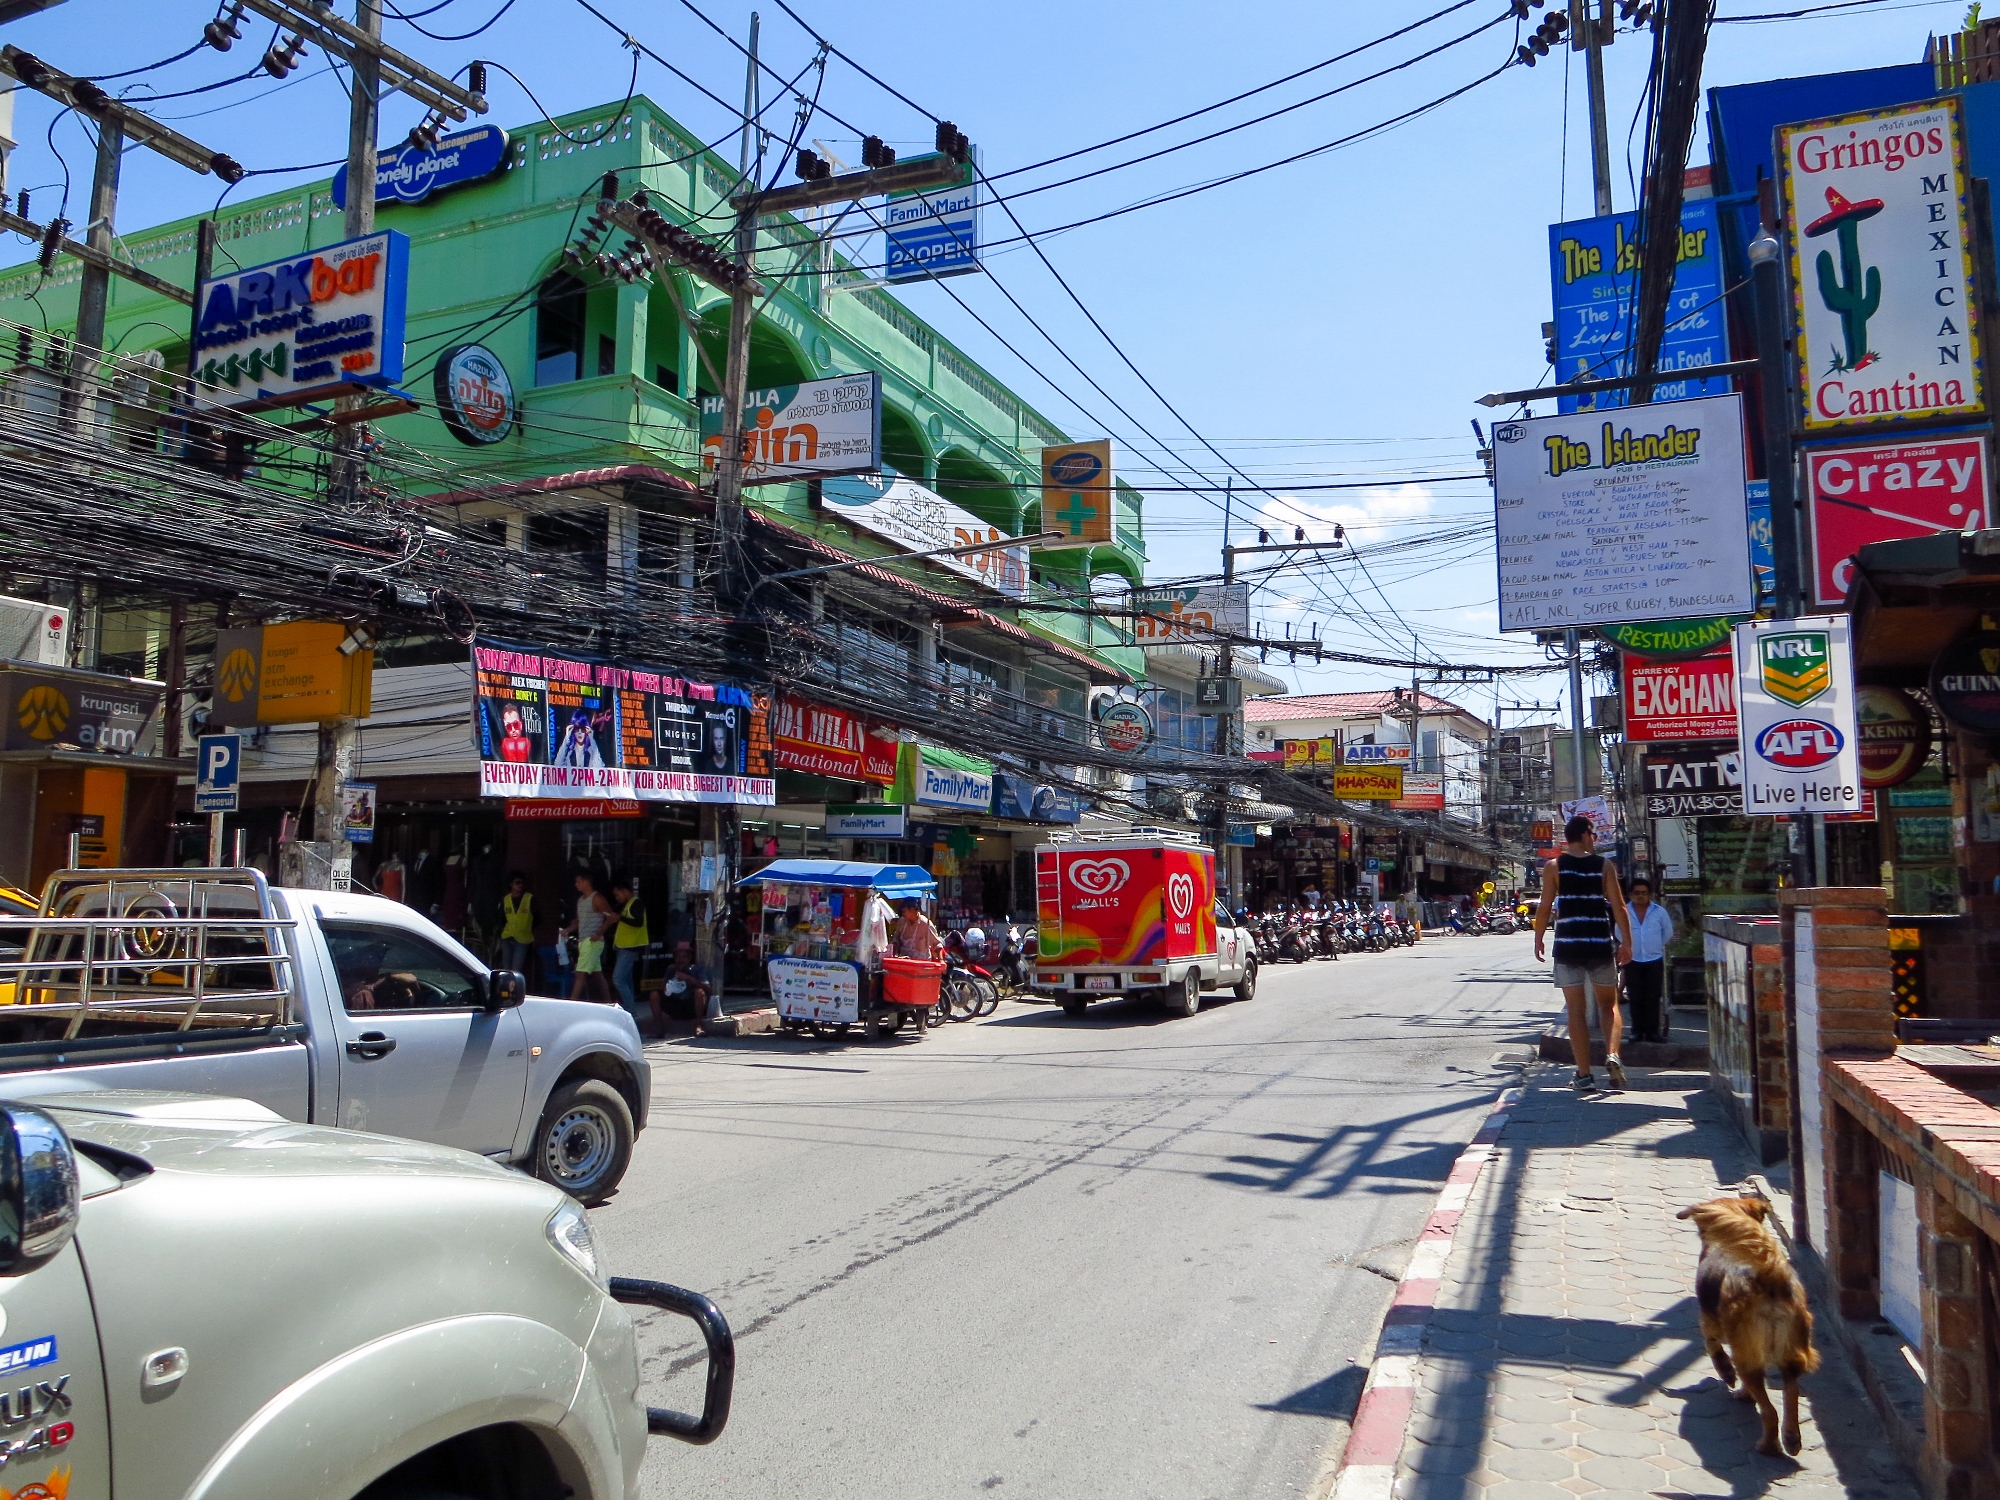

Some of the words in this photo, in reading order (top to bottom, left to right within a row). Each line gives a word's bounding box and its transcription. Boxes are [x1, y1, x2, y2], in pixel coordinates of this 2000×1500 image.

[1797, 127, 1943, 174] Gringos
[416, 152, 460, 181] planet
[890, 197, 970, 223] FamilyMart
[1560, 240, 1601, 285] The
[1919, 173, 1960, 366] MEXICAN
[1577, 307, 1610, 325] The
[1679, 292, 1699, 310] of
[1569, 326, 1625, 349] Live
[1677, 347, 1712, 367] Food
[467, 360, 495, 379] HAZULA
[1816, 373, 1966, 420] Cantina
[1543, 433, 1592, 477] The
[1602, 422, 1700, 469] Islander
[1645, 459, 1699, 470] RESTAURANT
[1817, 456, 1976, 496] Crazy
[1611, 490, 1668, 503] SOUTHAMPTON
[1634, 521, 1676, 530] ARSENAL
[1500, 555, 1533, 565] PREMIER
[1561, 549, 1580, 558] MAN
[1585, 547, 1605, 556] CITY
[1622, 544, 1645, 553] WEST
[1556, 557, 1605, 568] NEWCASTLE
[1583, 568, 1609, 577] ASTON
[1572, 586, 1595, 596] RACE
[1583, 601, 1621, 615] SUPER
[48, 632, 60, 640] LG
[1617, 617, 1731, 649] RESTAURANT
[1766, 639, 1824, 660] NRL
[265, 664, 286, 675] atm
[475, 646, 541, 677] SONGKRAN
[632, 671, 661, 694] WEEK
[1632, 667, 1680, 676] CURRENCY
[264, 674, 315, 688] exchange
[81, 694, 139, 716] krungsri
[1632, 673, 1737, 716] EXCHAN
[665, 701, 697, 715] THURSDAY
[79, 720, 138, 748] atm
[480, 702, 491, 756] MONDAY
[664, 729, 696, 740] NIGHTS
[808, 710, 866, 752] MILAN
[1646, 720, 1688, 729] Authorized
[1689, 720, 1716, 728] Money
[1653, 730, 1685, 738] License
[1685, 729, 1699, 737] No.
[1763, 729, 1839, 757] AFL
[209, 746, 230, 780] P
[866, 755, 895, 776] Suits
[484, 762, 539, 785] EVERYDAY
[541, 766, 568, 787] FROM
[571, 767, 620, 788] 2PM-2AM
[622, 773, 632, 788] AT
[634, 770, 655, 790] KOH
[657, 772, 691, 791] SAMUI'S
[693, 775, 724, 793] BIGGEST
[750, 779, 774, 796] HOTEL
[924, 770, 990, 801] FamilyMart
[1753, 783, 1796, 804] Live
[1803, 782, 1855, 803] Here
[508, 802, 604, 818] International
[611, 799, 640, 812] Suits
[840, 818, 886, 830] FamilyMart
[1369, 859, 1376, 868] P
[1081, 897, 1120, 908] WALL'S
